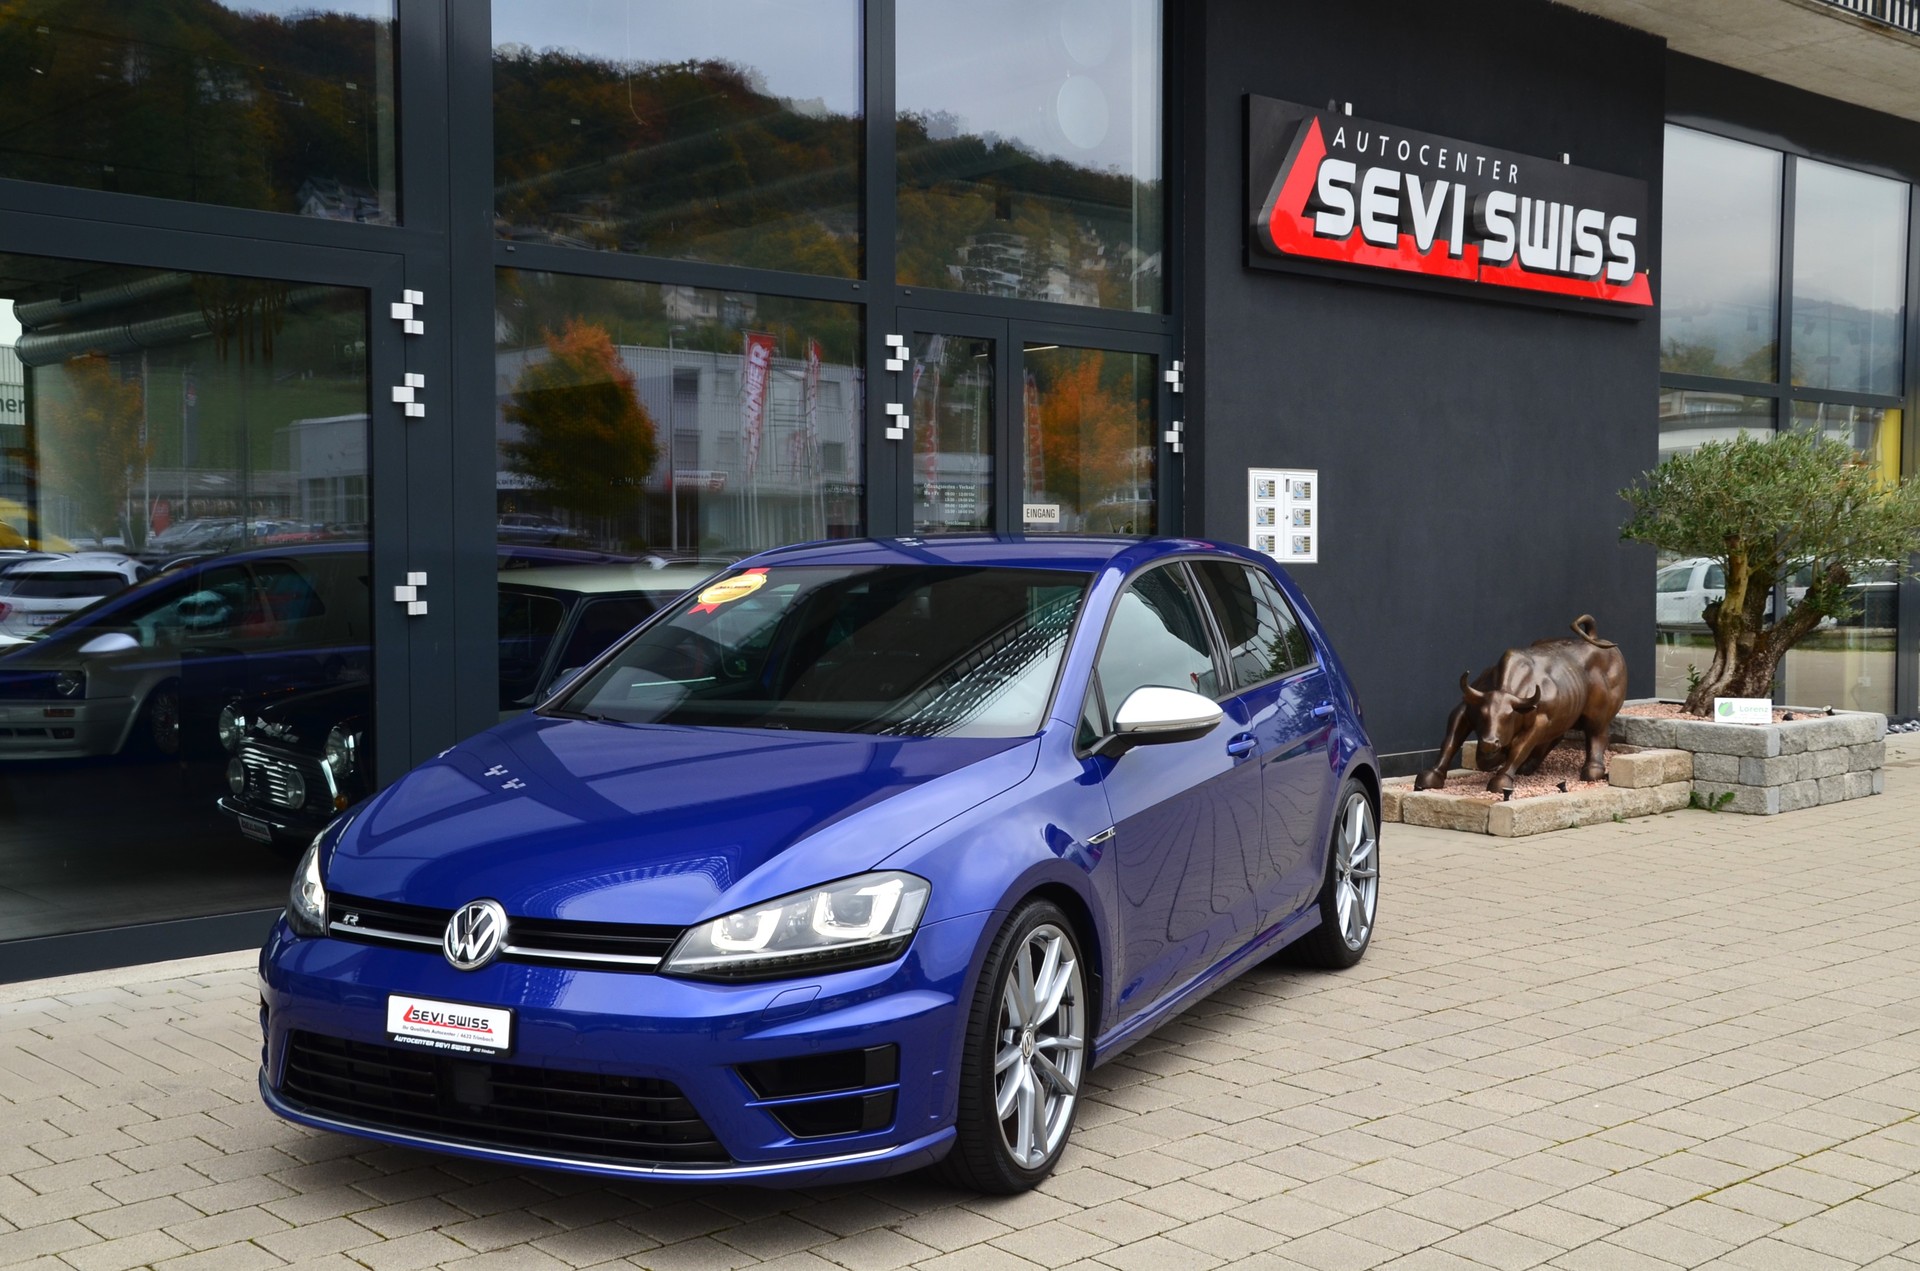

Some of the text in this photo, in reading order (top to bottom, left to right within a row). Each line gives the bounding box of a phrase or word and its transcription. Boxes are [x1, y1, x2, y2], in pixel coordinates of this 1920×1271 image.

[1332, 126, 1519, 184] AUTOCENTER
[1313, 158, 1638, 282] SEVI SWISS
[1026, 508, 1056, 519] EINGANG
[1739, 705, 1769, 713] Lorenz
[411, 1009, 489, 1030] SEVI SWISS
